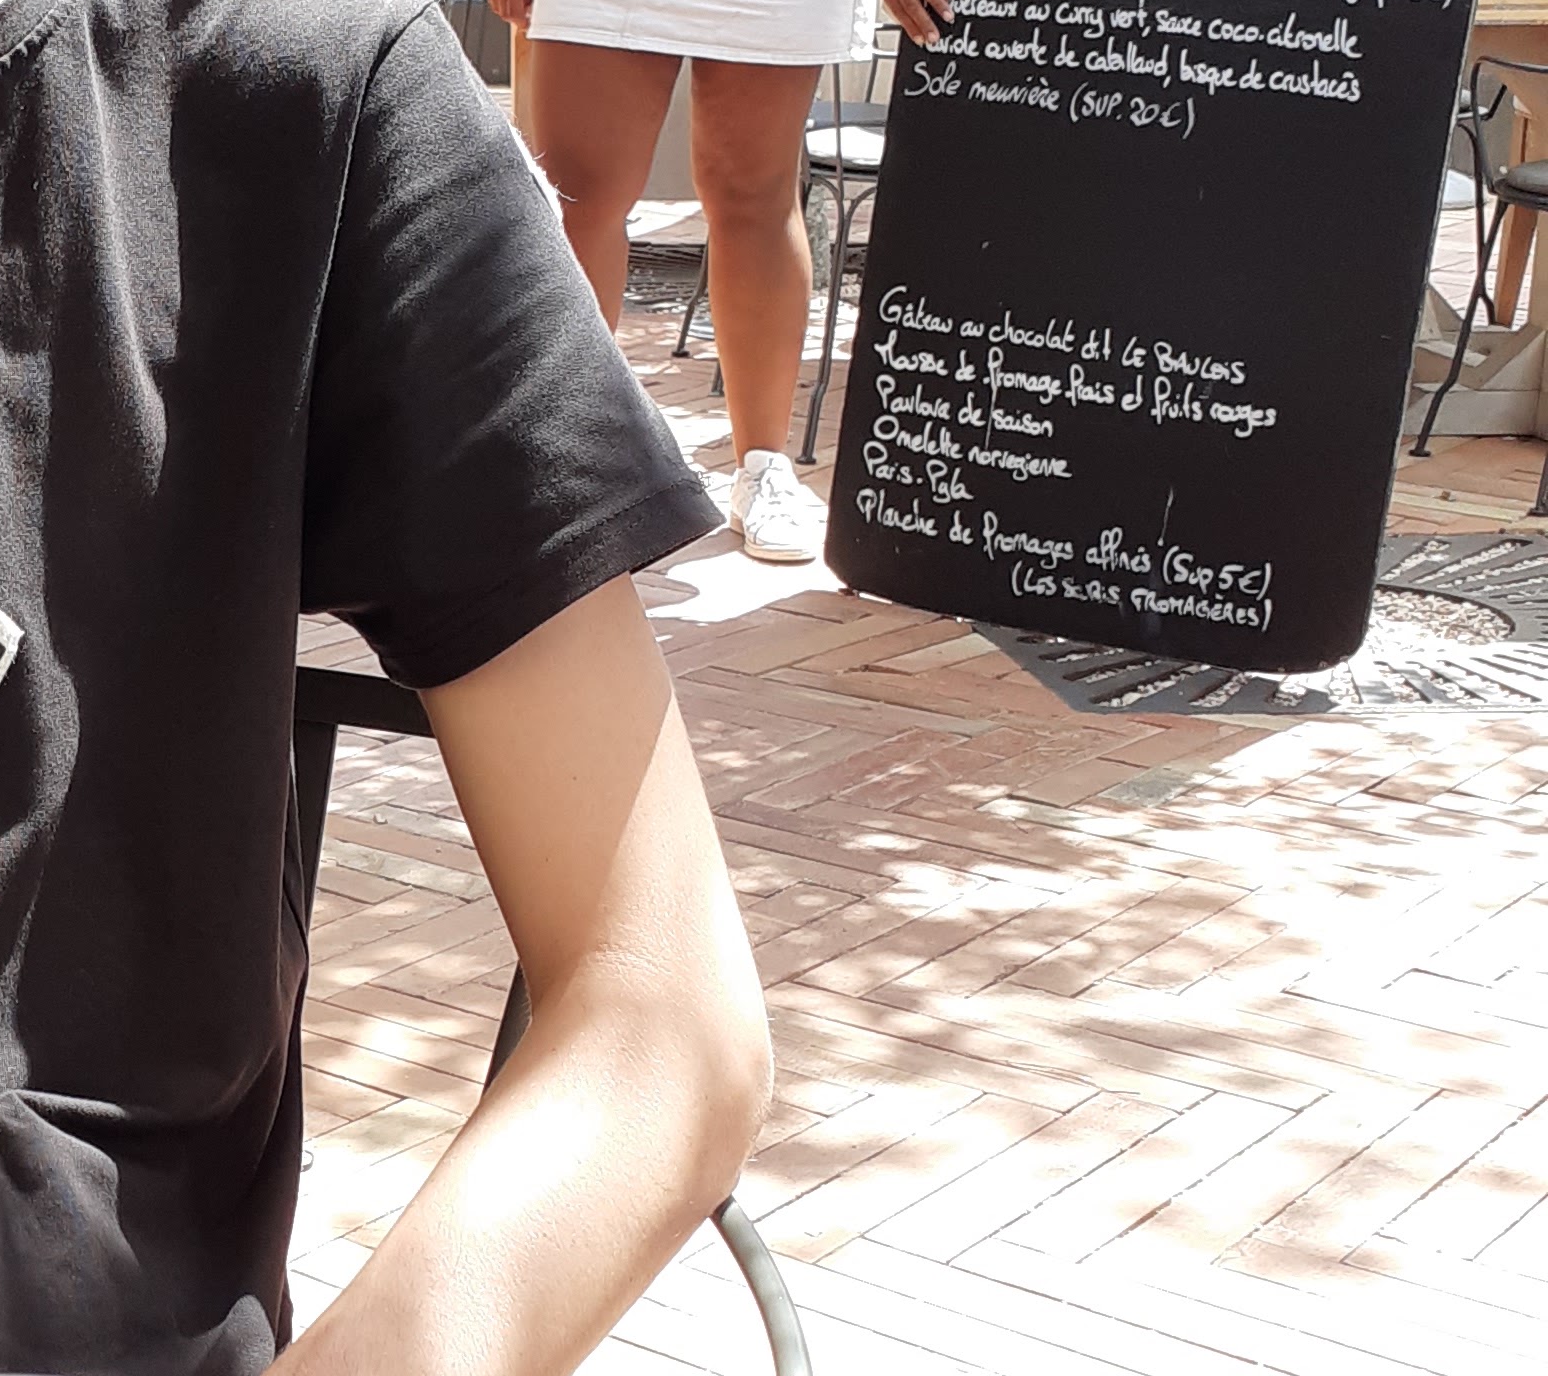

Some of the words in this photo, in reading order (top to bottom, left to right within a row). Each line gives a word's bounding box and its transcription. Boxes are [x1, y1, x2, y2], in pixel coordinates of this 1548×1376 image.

[1024, 2, 1051, 22] au
[904, 60, 962, 97] Sole
[1054, 34, 1081, 68] de
[1239, 58, 1267, 90] de
[879, 284, 953, 334] Gâteau
[960, 320, 985, 337] au
[988, 310, 1076, 352] chocolat
[954, 349, 977, 382] de
[1120, 374, 1144, 412] et
[873, 414, 964, 460] Omelette
[957, 391, 987, 427] de
[992, 408, 1054, 438] saison
[949, 509, 975, 545] de
